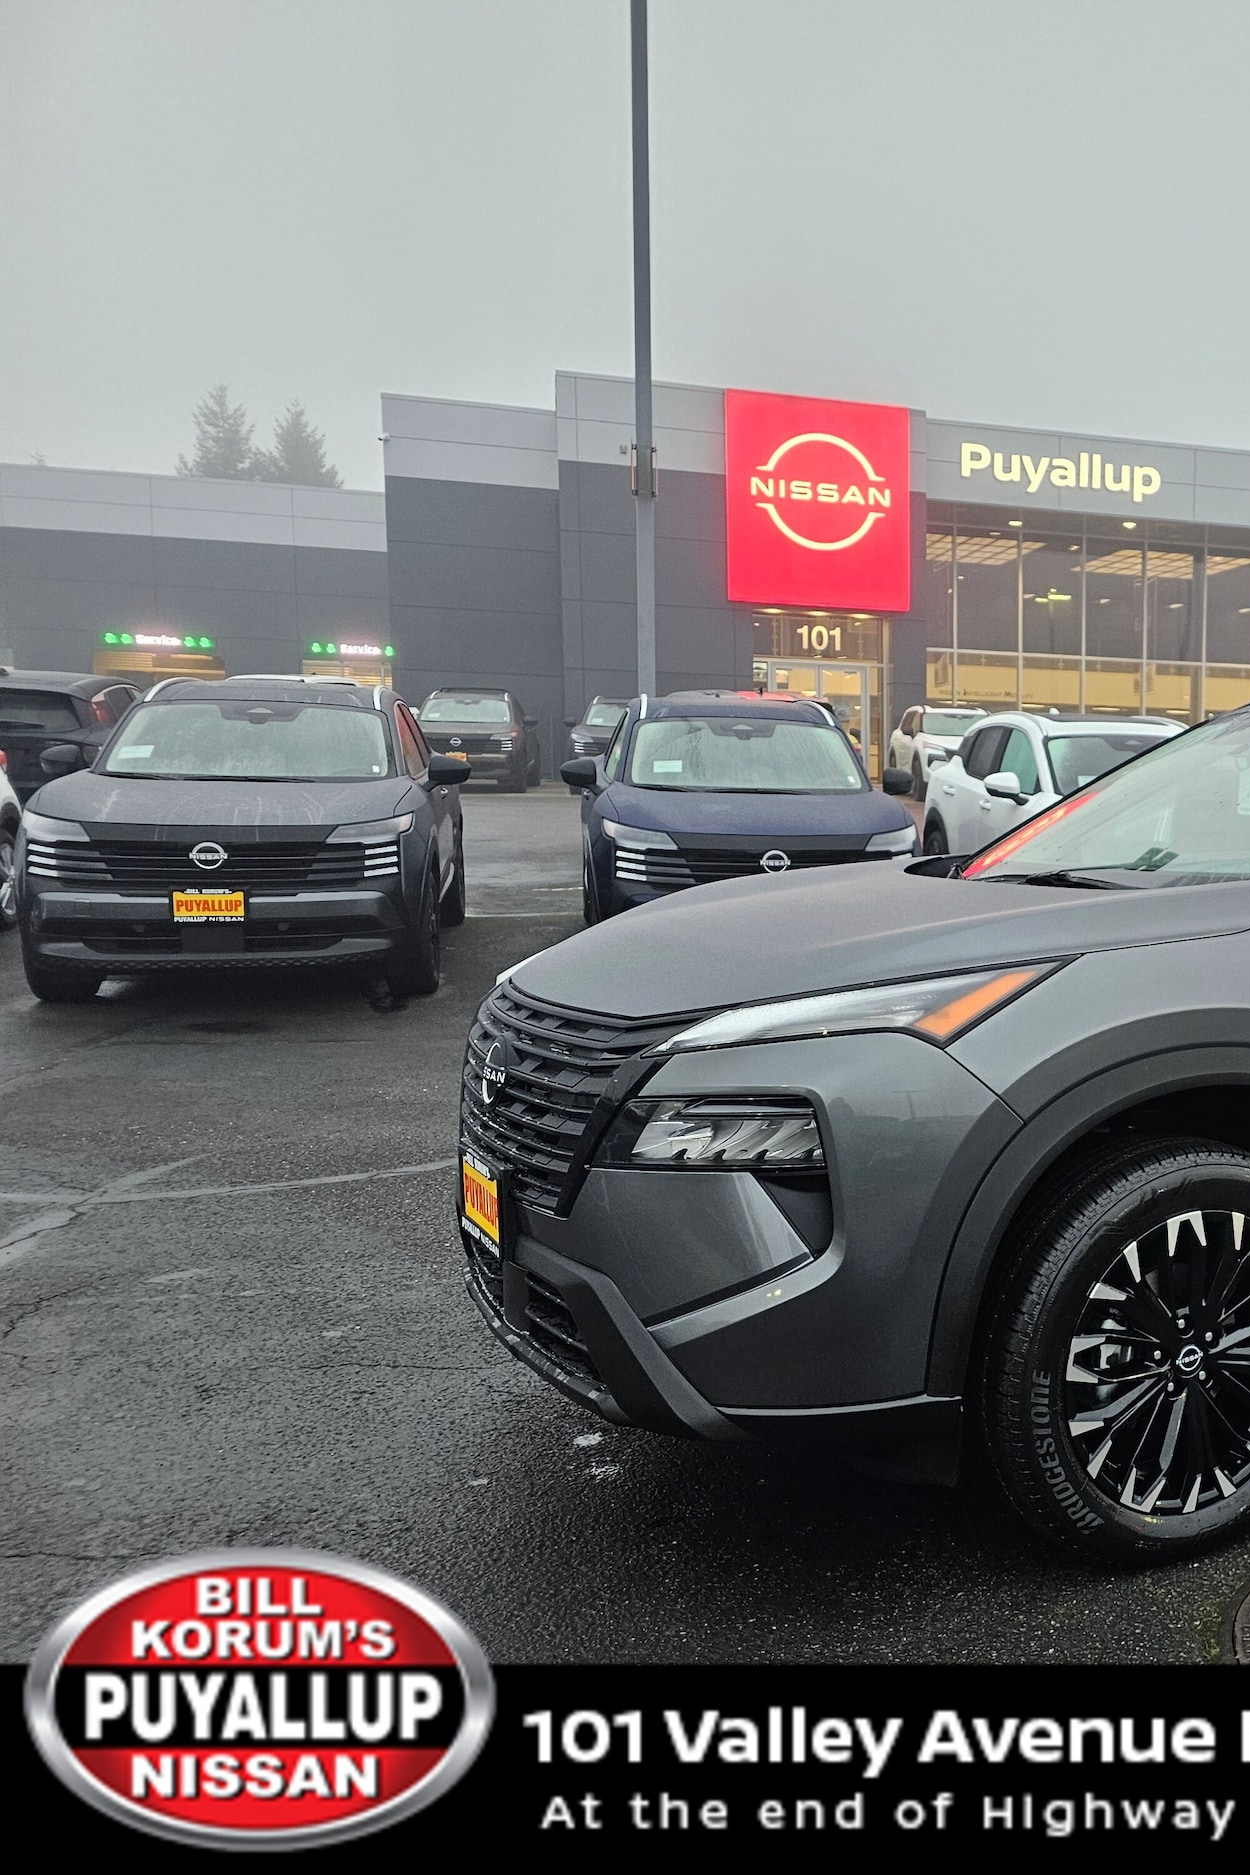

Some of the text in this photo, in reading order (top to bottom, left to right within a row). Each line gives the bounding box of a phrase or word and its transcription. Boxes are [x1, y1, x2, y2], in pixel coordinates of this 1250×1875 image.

[961, 443, 1161, 501] Puyallup
[750, 476, 891, 508] NISSAN
[135, 634, 182, 646] Service
[340, 643, 382, 655] Service
[796, 625, 842, 651] 101
[175, 899, 243, 913] PUYALLUP
[463, 1171, 499, 1230] PUYALLUP
[1030, 1368, 1105, 1535] BRIDGESTONE
